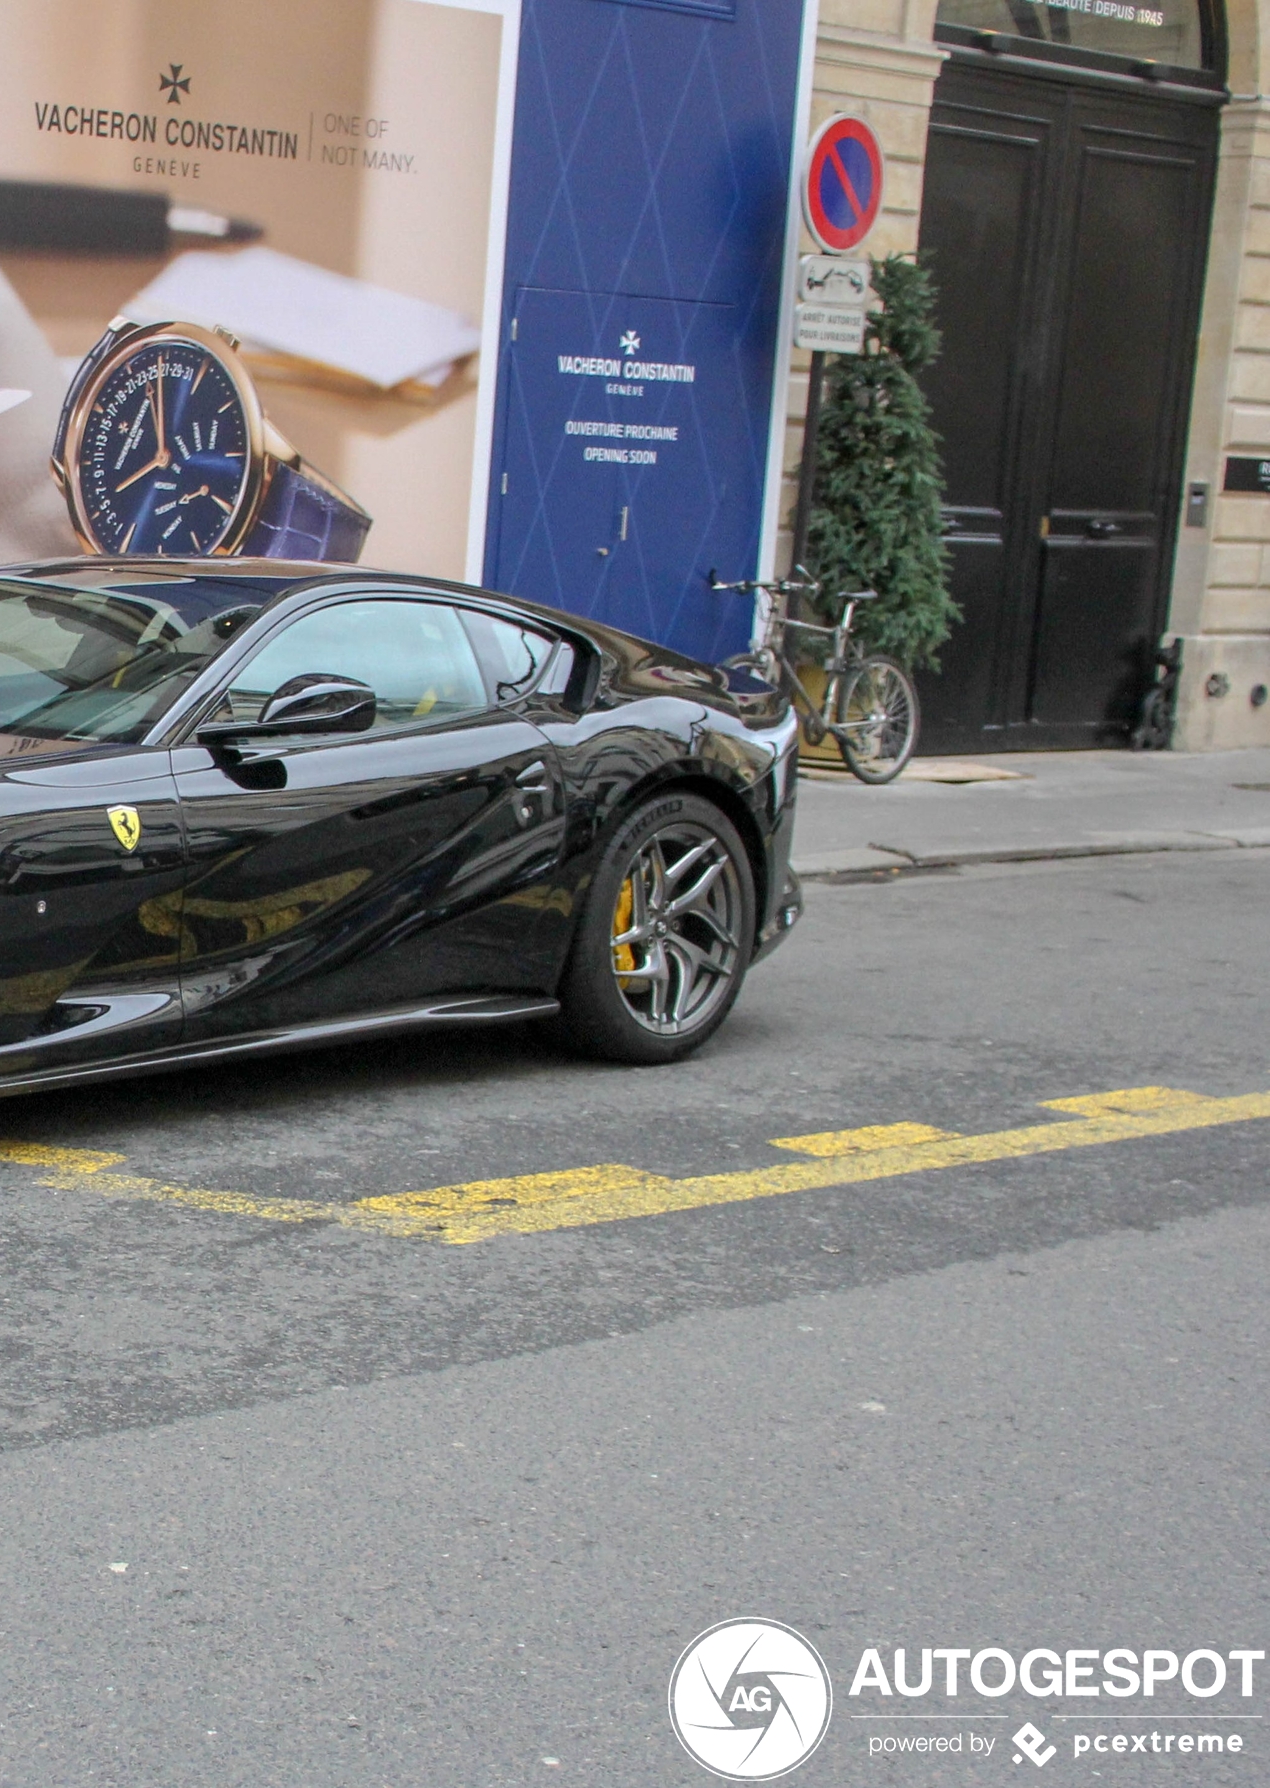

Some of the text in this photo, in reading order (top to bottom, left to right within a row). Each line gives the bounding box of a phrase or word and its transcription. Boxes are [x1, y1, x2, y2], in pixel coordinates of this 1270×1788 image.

[1095, 0, 1135, 21] DEPUIS
[1138, 9, 1164, 26] 1945
[35, 102, 298, 160] VACHERON CONSTANTIN
[324, 112, 389, 139] ONE OF
[322, 144, 418, 174] NOT MANY.
[799, 328, 818, 340] POUR
[558, 355, 695, 383] VACHERON CONSTANTIN
[129, 398, 150, 438] CONSTANTIN
[565, 420, 679, 441] OUVERTURE PROCHAINE
[208, 420, 219, 450] SUNDAY
[583, 446, 658, 465] OPENING SOON
